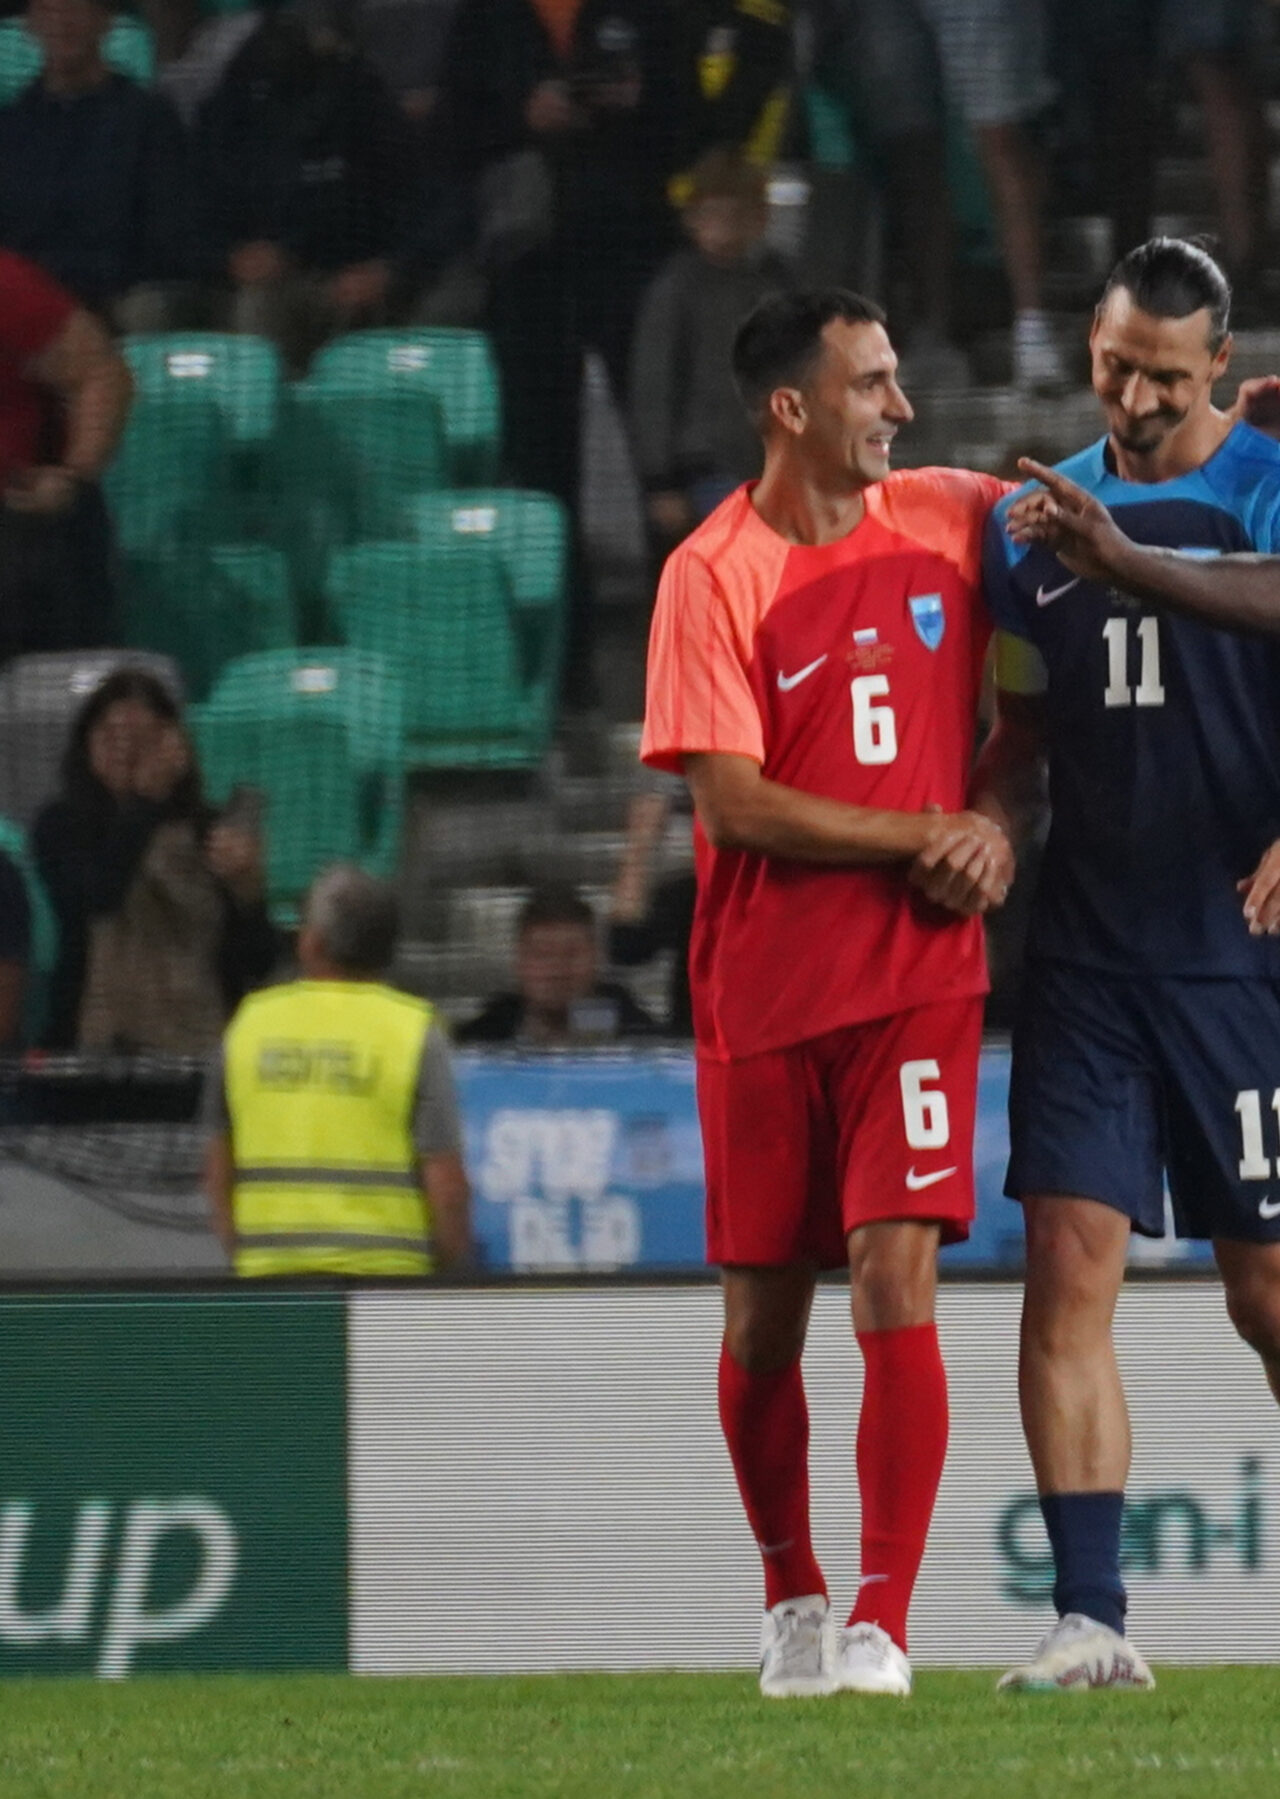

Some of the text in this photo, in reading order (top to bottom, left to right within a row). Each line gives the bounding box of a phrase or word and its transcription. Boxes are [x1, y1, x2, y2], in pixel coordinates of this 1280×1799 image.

[1102, 616, 1166, 708] 11
[851, 674, 898, 765] 6
[899, 1058, 950, 1150] 6
